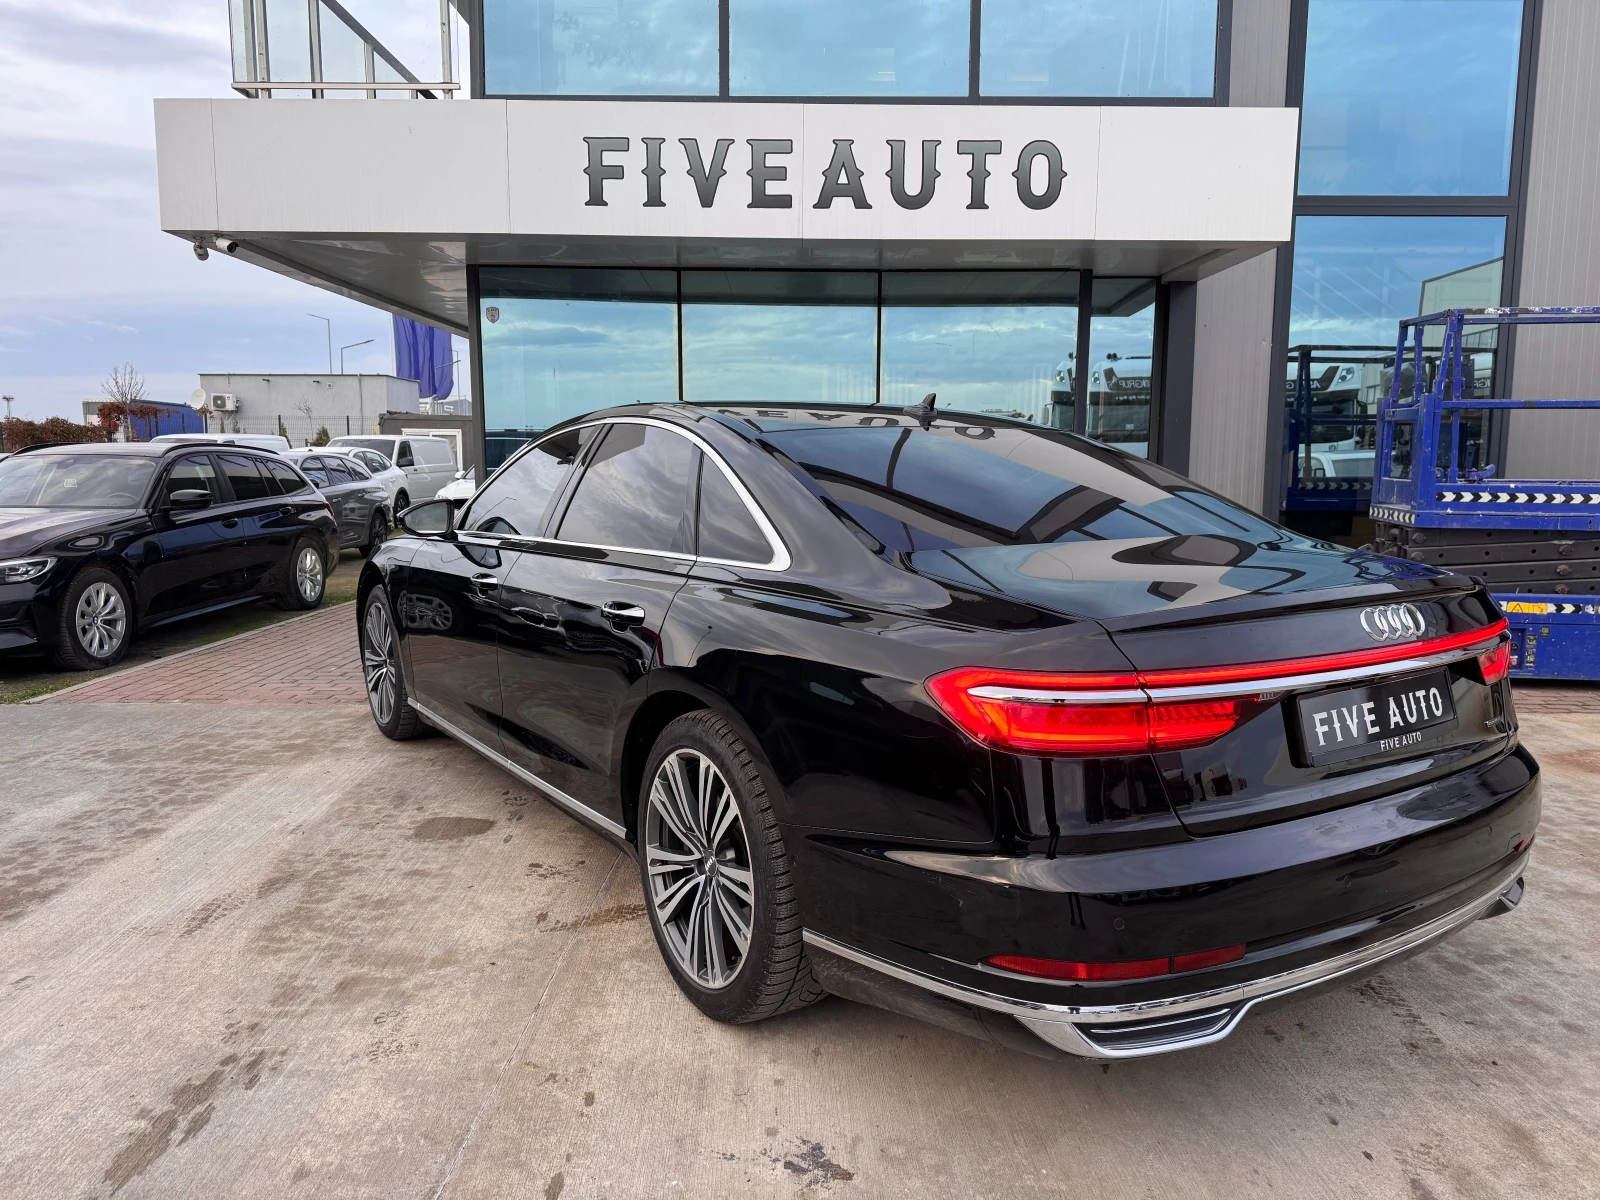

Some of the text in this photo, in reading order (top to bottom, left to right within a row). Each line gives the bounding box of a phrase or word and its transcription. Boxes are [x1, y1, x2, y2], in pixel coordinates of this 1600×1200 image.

[1313, 687, 1443, 746] FIVE AUTO
[1380, 731, 1422, 751] FIVE AUTO
